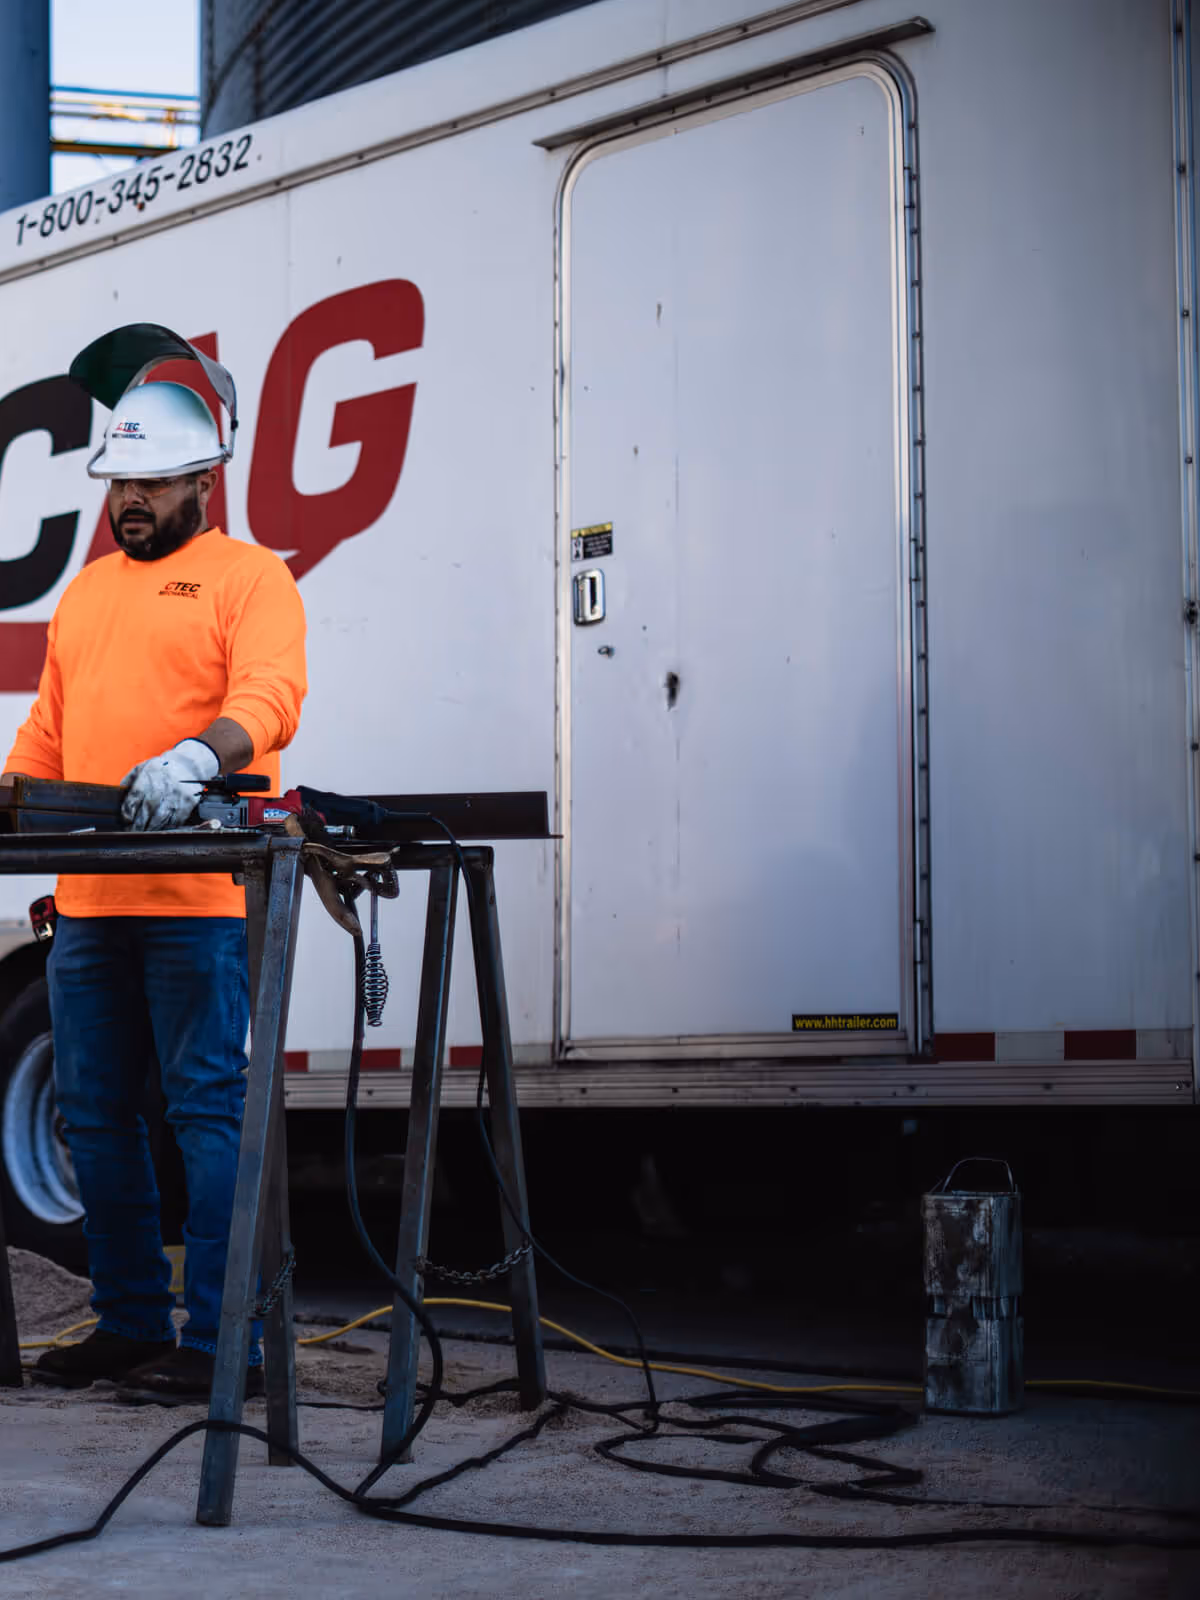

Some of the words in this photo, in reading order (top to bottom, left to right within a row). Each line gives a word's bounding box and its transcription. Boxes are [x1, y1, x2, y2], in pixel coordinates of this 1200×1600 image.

[17, 134, 253, 246] 1-800-345-2832
[164, 581, 201, 592] CTEC
[795, 1015, 897, 1029] www.hhtrailer.com
